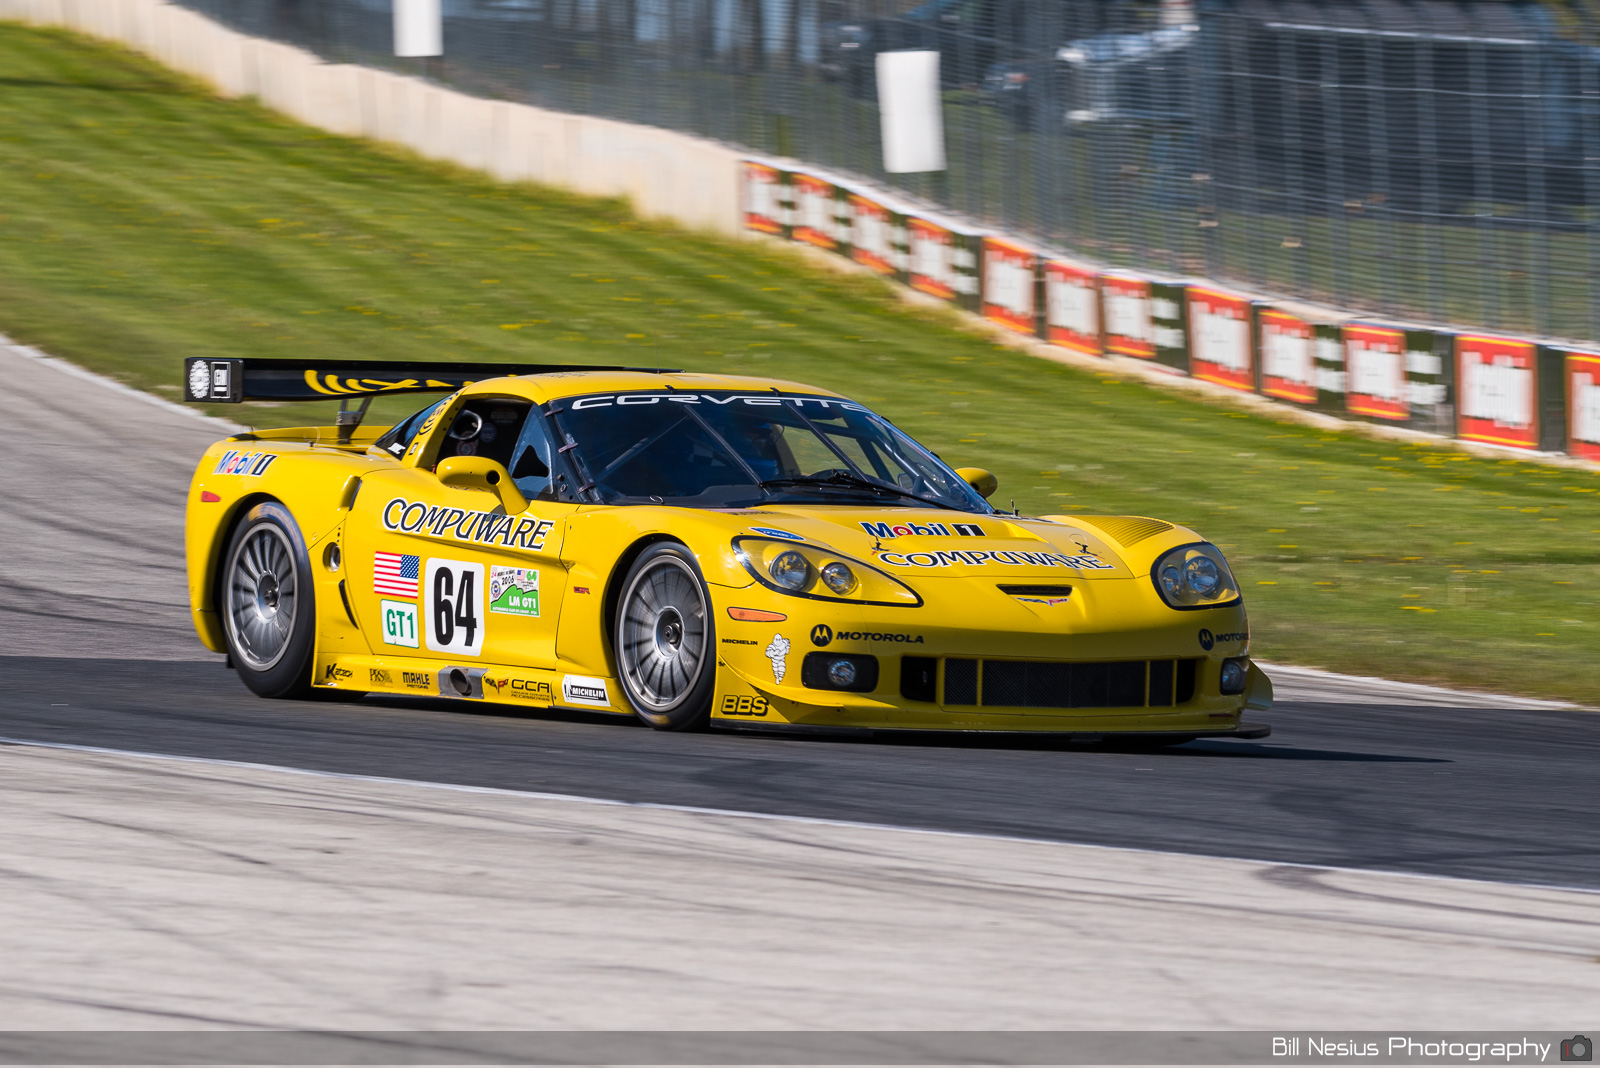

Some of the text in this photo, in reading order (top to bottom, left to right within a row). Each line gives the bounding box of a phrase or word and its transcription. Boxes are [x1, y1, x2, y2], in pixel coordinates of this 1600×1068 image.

[571, 394, 873, 413] CORVETTE
[212, 450, 277, 476] Mobil 1
[383, 498, 554, 550] COMPUWARE
[860, 522, 985, 538] Mobil 1
[879, 551, 1114, 570] COMPUWARE
[501, 575, 515, 586] 2006
[526, 570, 537, 581] 64
[433, 566, 478, 647] 64
[509, 595, 537, 609] LM GT1
[386, 608, 414, 640] GT1
[721, 637, 758, 646] MICHELIN
[836, 631, 925, 644] MOTOROLA
[402, 671, 431, 686] MAHLE
[511, 678, 550, 693] GCA
[572, 686, 605, 698] MICHELIN
[721, 694, 770, 717] BBS
